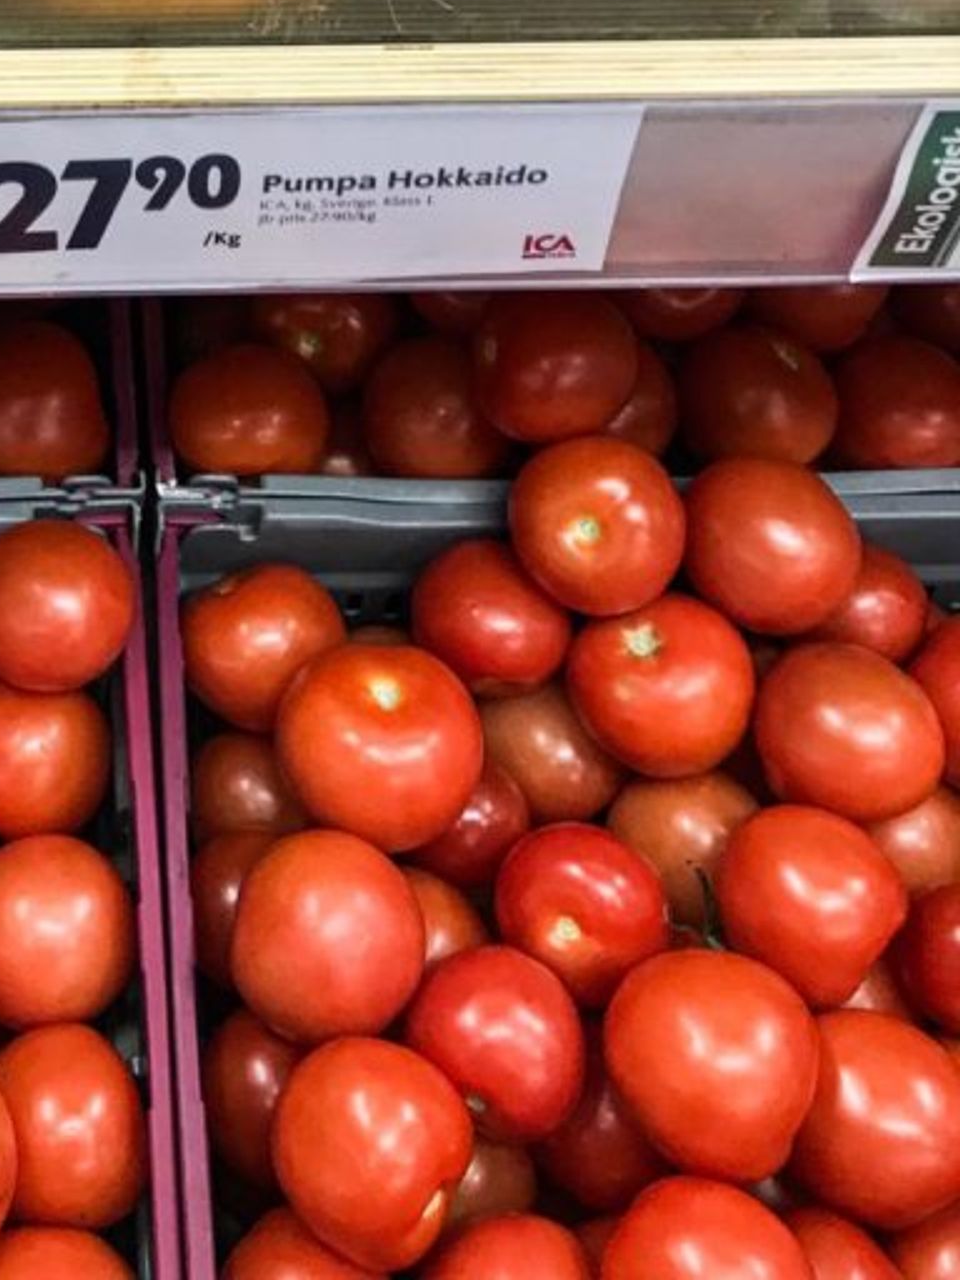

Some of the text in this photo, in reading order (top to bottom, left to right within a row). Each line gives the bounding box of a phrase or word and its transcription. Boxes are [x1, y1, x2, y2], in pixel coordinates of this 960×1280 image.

[262, 164, 549, 197] Pumpa Hokkaido
[203, 230, 242, 250] /Kg
[522, 234, 576, 252] ICA
